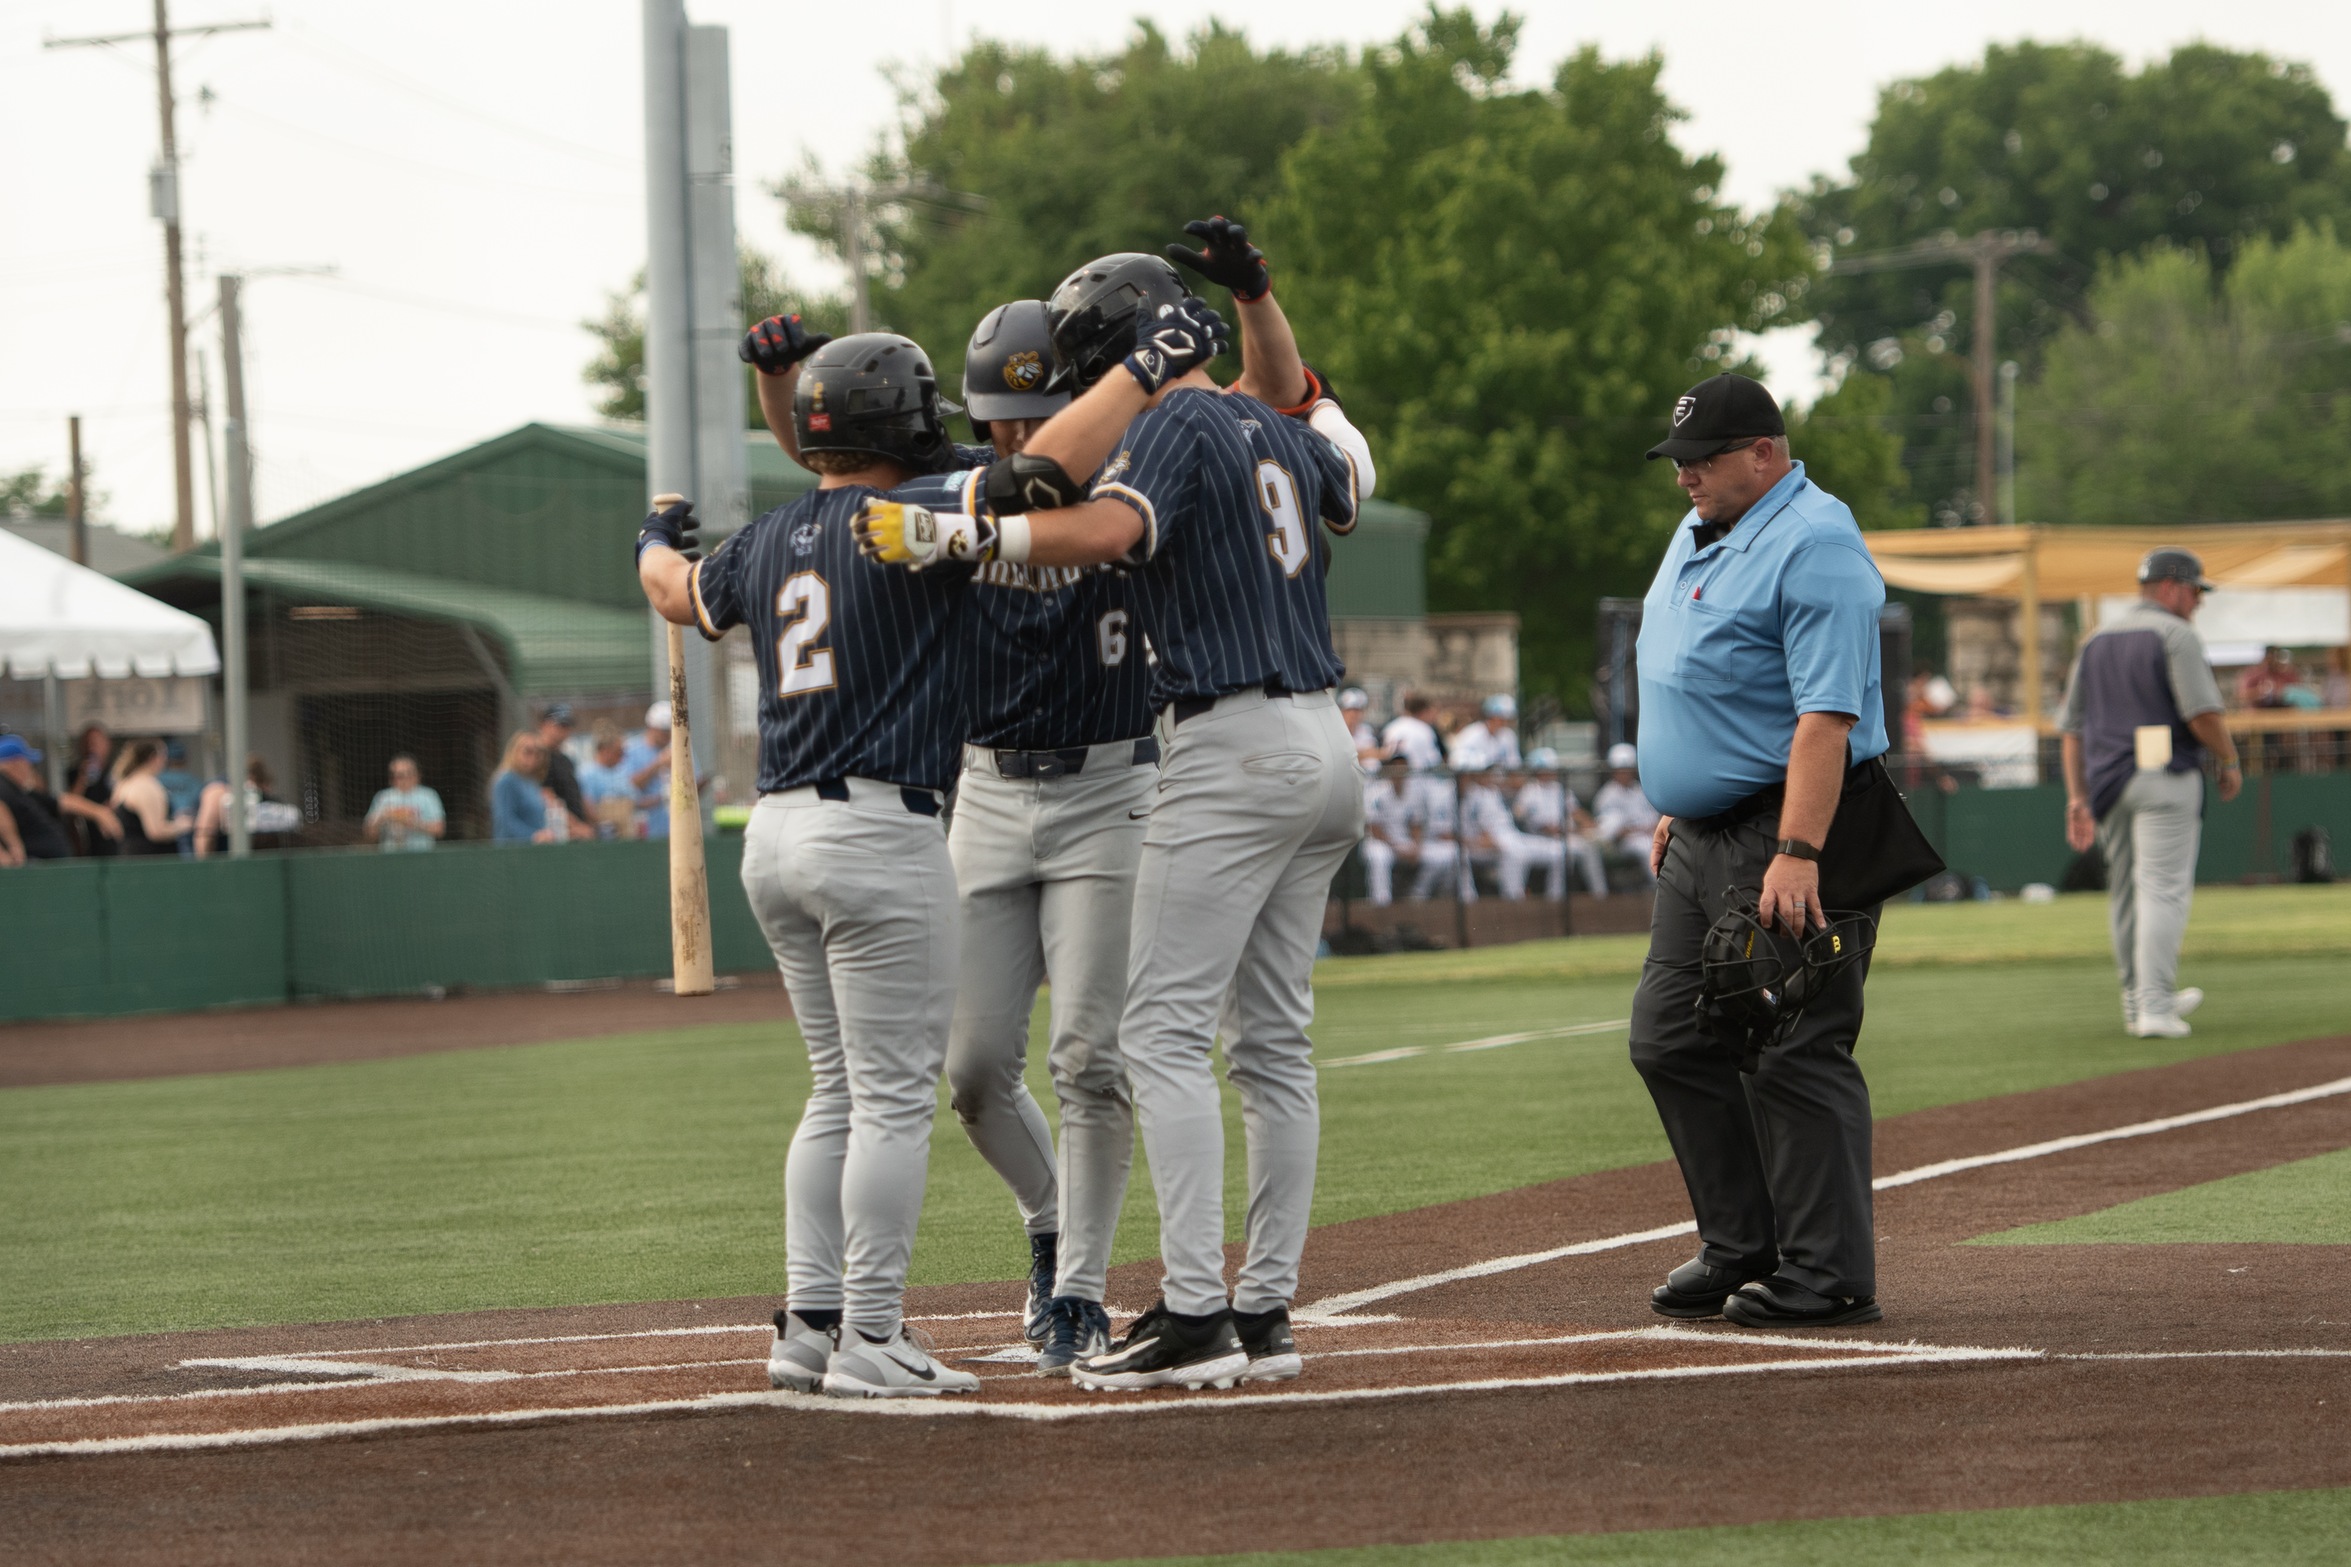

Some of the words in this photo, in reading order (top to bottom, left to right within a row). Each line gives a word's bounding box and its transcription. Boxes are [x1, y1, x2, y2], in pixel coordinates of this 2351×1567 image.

[1255, 459, 1310, 579] 9
[776, 569, 838, 698] 2
[1098, 608, 1129, 667] 6
